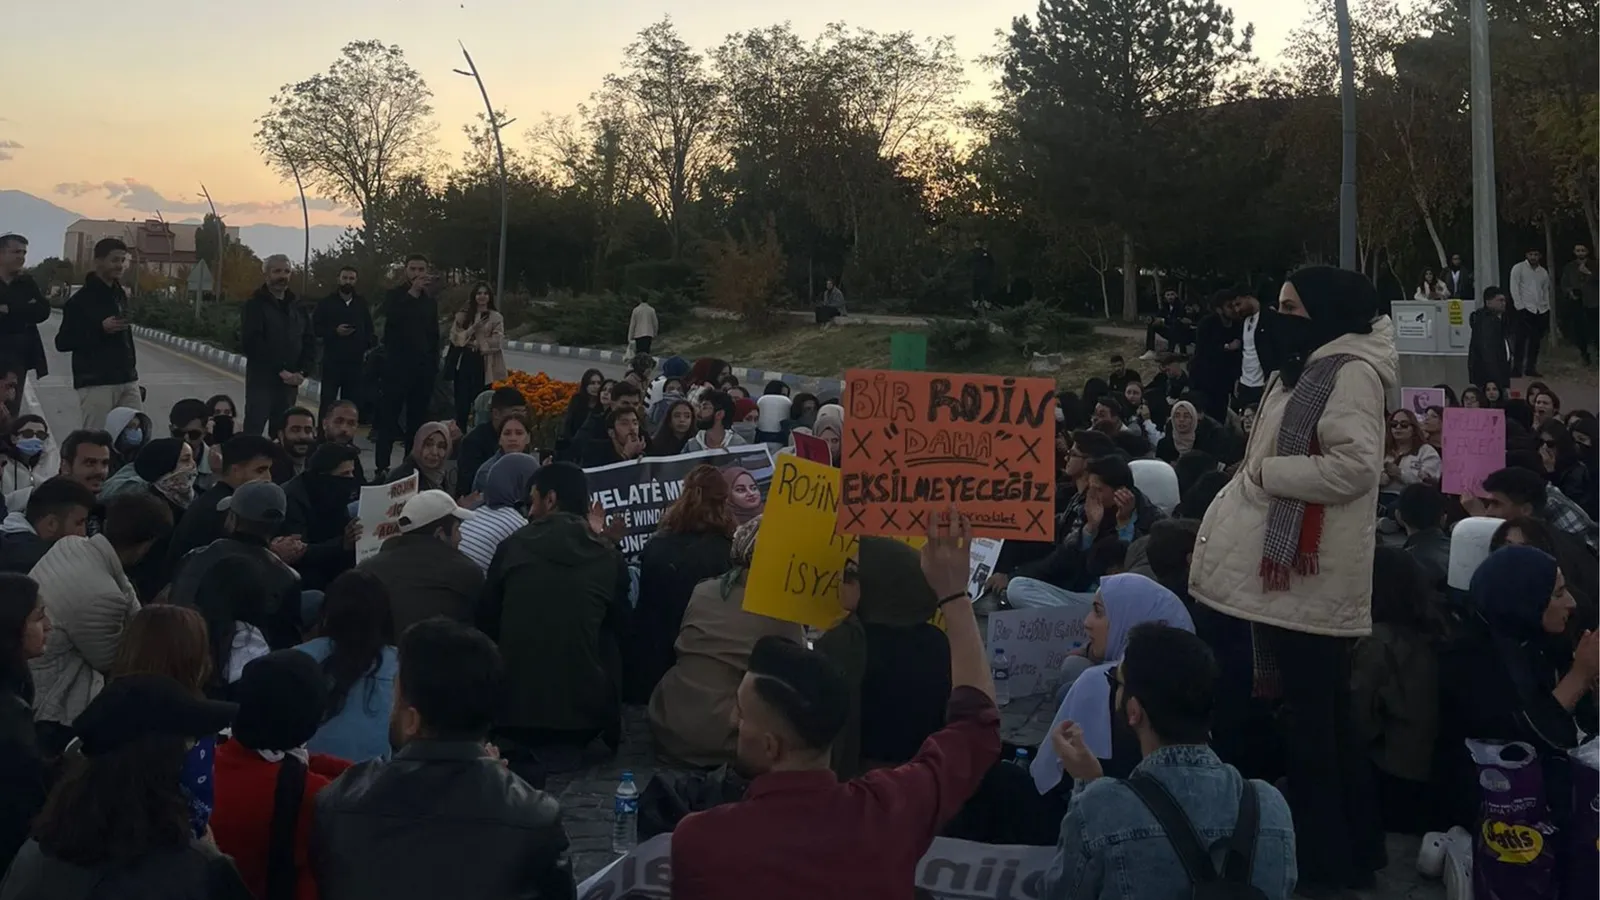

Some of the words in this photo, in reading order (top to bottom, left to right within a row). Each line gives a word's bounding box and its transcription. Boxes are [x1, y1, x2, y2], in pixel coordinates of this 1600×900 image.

[850, 372, 915, 422] BİR
[927, 377, 1055, 429] ROJİN
[778, 462, 840, 513] ROJİN
[784, 553, 840, 600] İSYA
